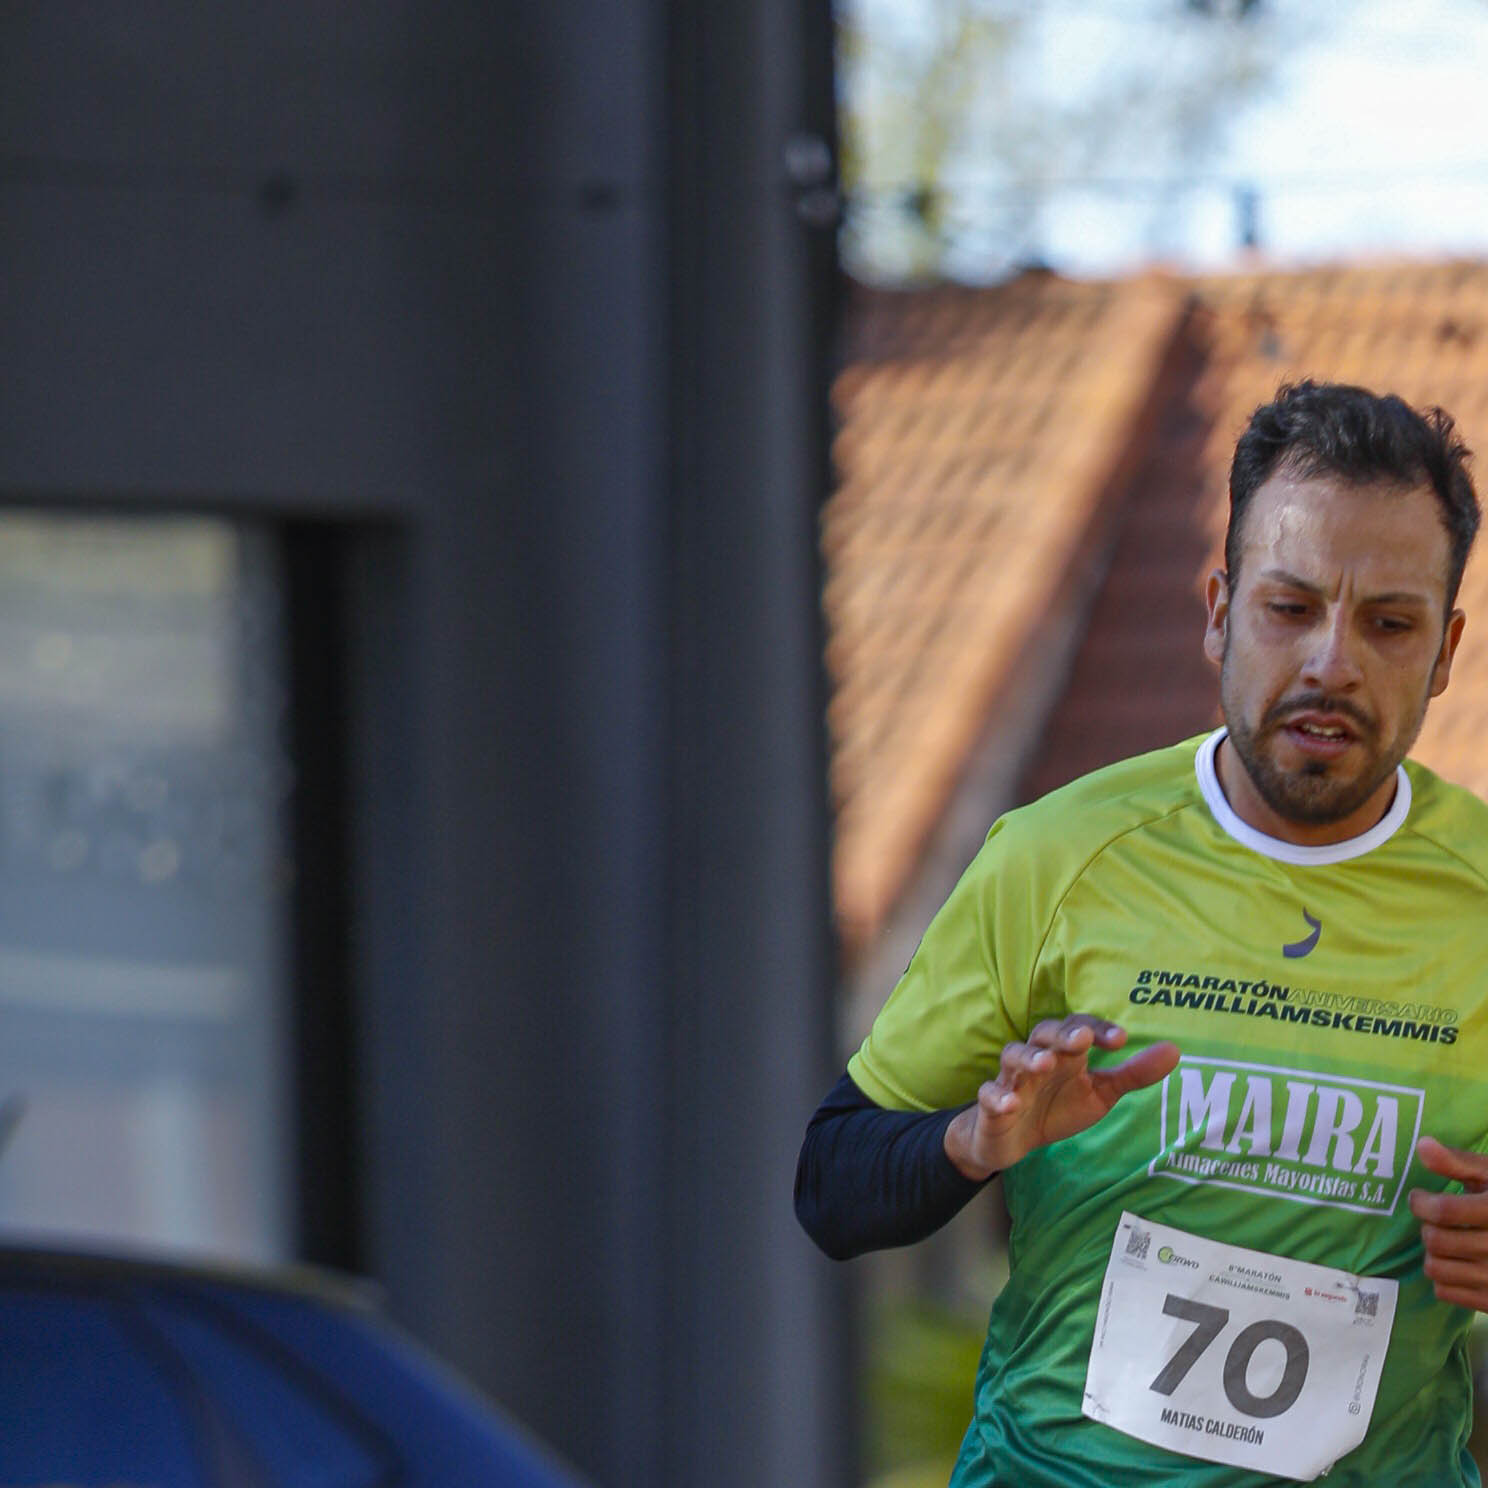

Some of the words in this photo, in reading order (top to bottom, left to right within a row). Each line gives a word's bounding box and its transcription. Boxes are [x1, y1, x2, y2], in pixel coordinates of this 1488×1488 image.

[1128, 985, 1460, 1046] CAWILLIAMSKEMMIS
[1177, 1067, 1399, 1179] MAIRA
[1165, 1151, 1260, 1182] Almacenes
[1263, 1162, 1357, 1199] Mayoristas
[1359, 1181, 1386, 1204] S.A.
[1149, 1293, 1310, 1420] 70
[1160, 1407, 1205, 1432] MATIAS
[1205, 1418, 1265, 1446] CALDERÓN
